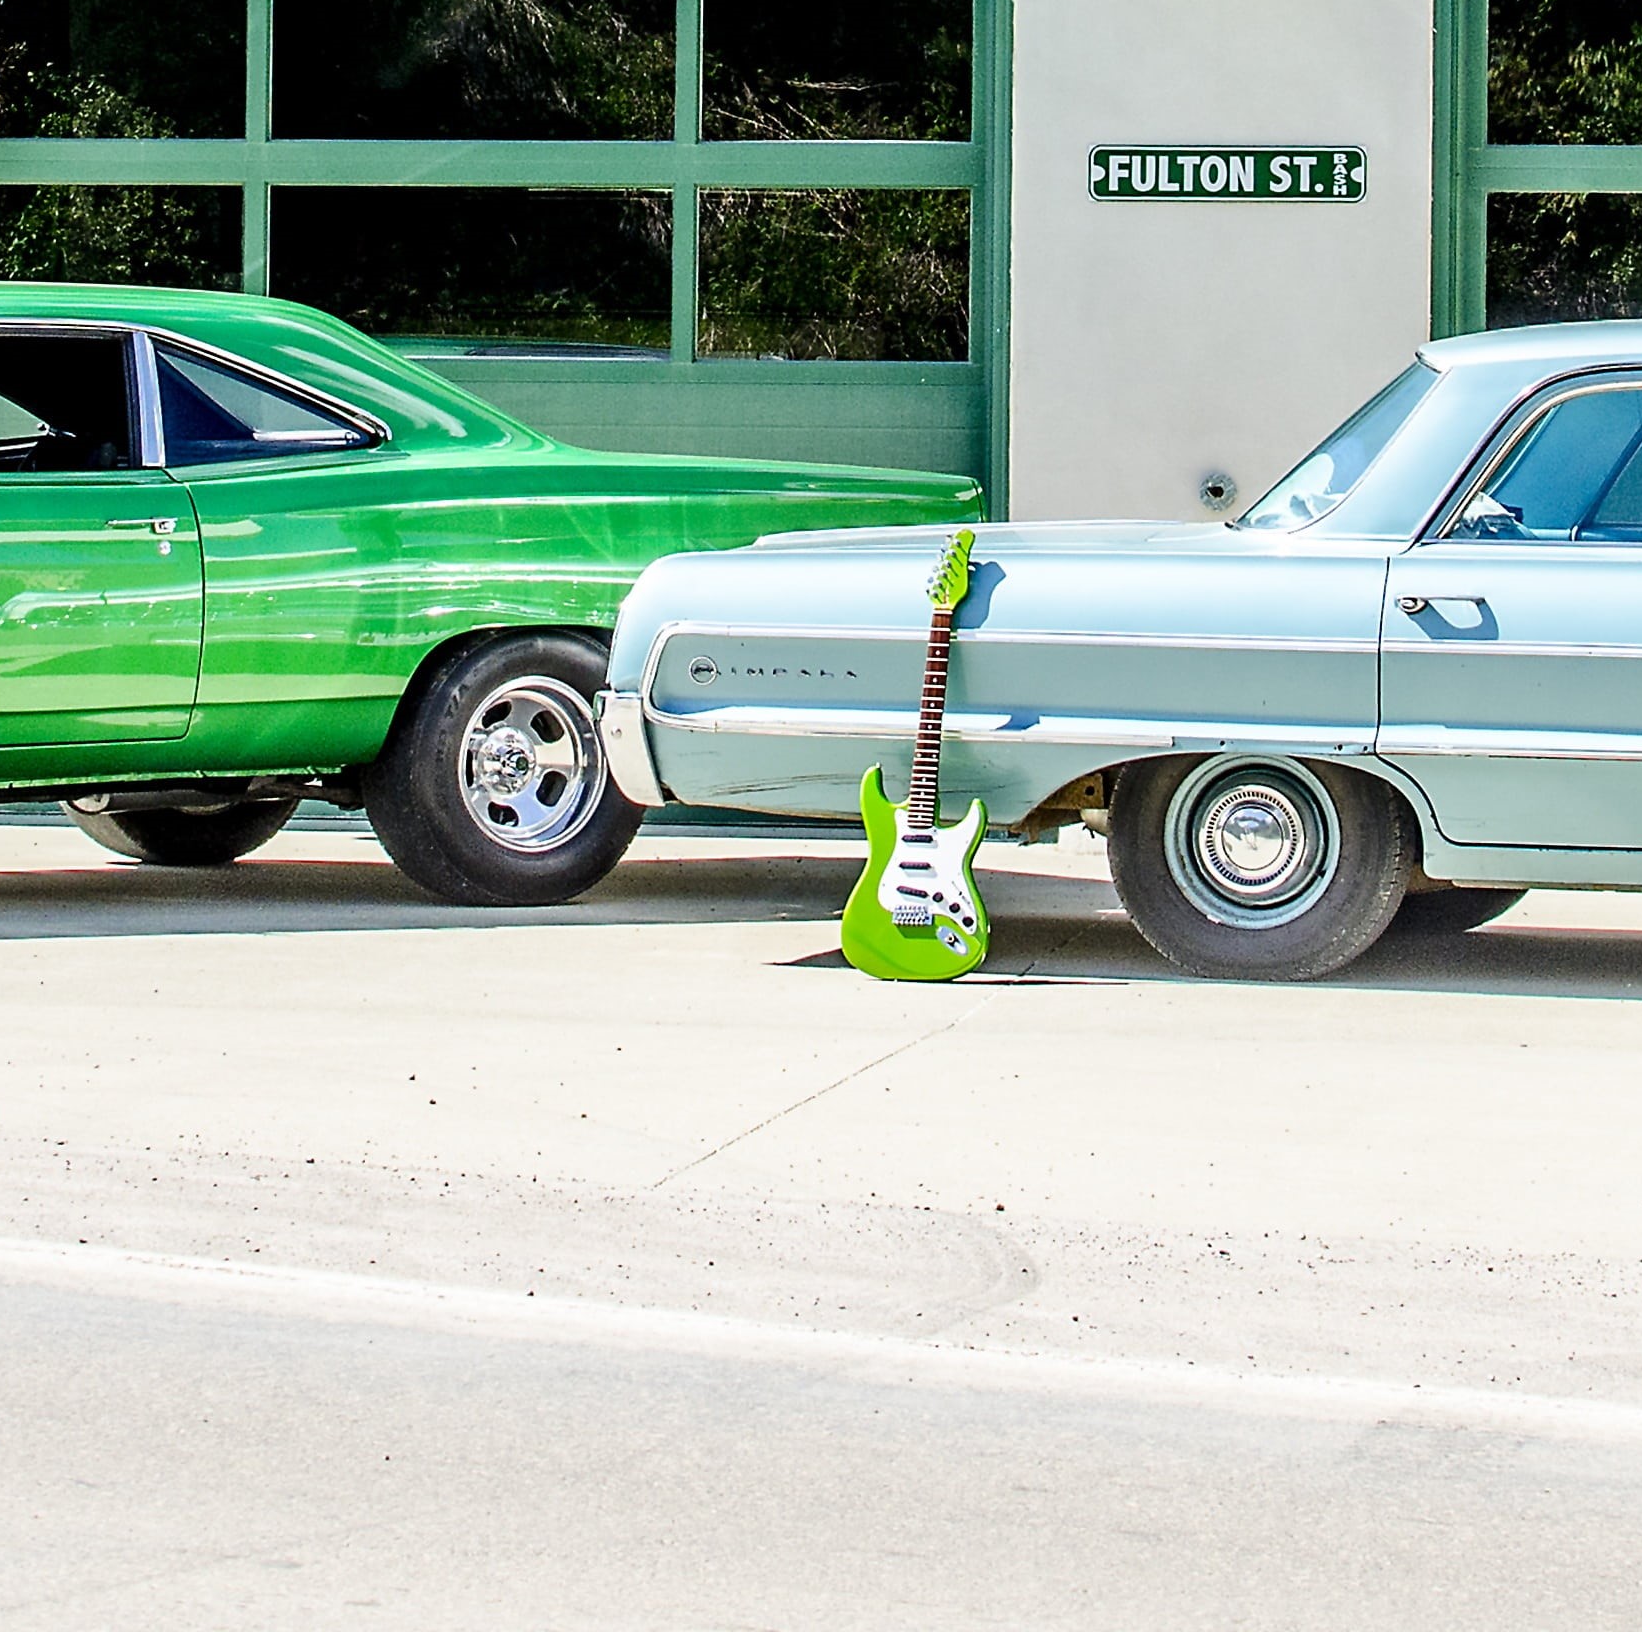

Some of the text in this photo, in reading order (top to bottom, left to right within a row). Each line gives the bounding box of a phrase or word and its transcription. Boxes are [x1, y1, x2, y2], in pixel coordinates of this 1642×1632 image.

[1108, 155, 1324, 193] FULTON ST.
[1332, 153, 1348, 196] BASH
